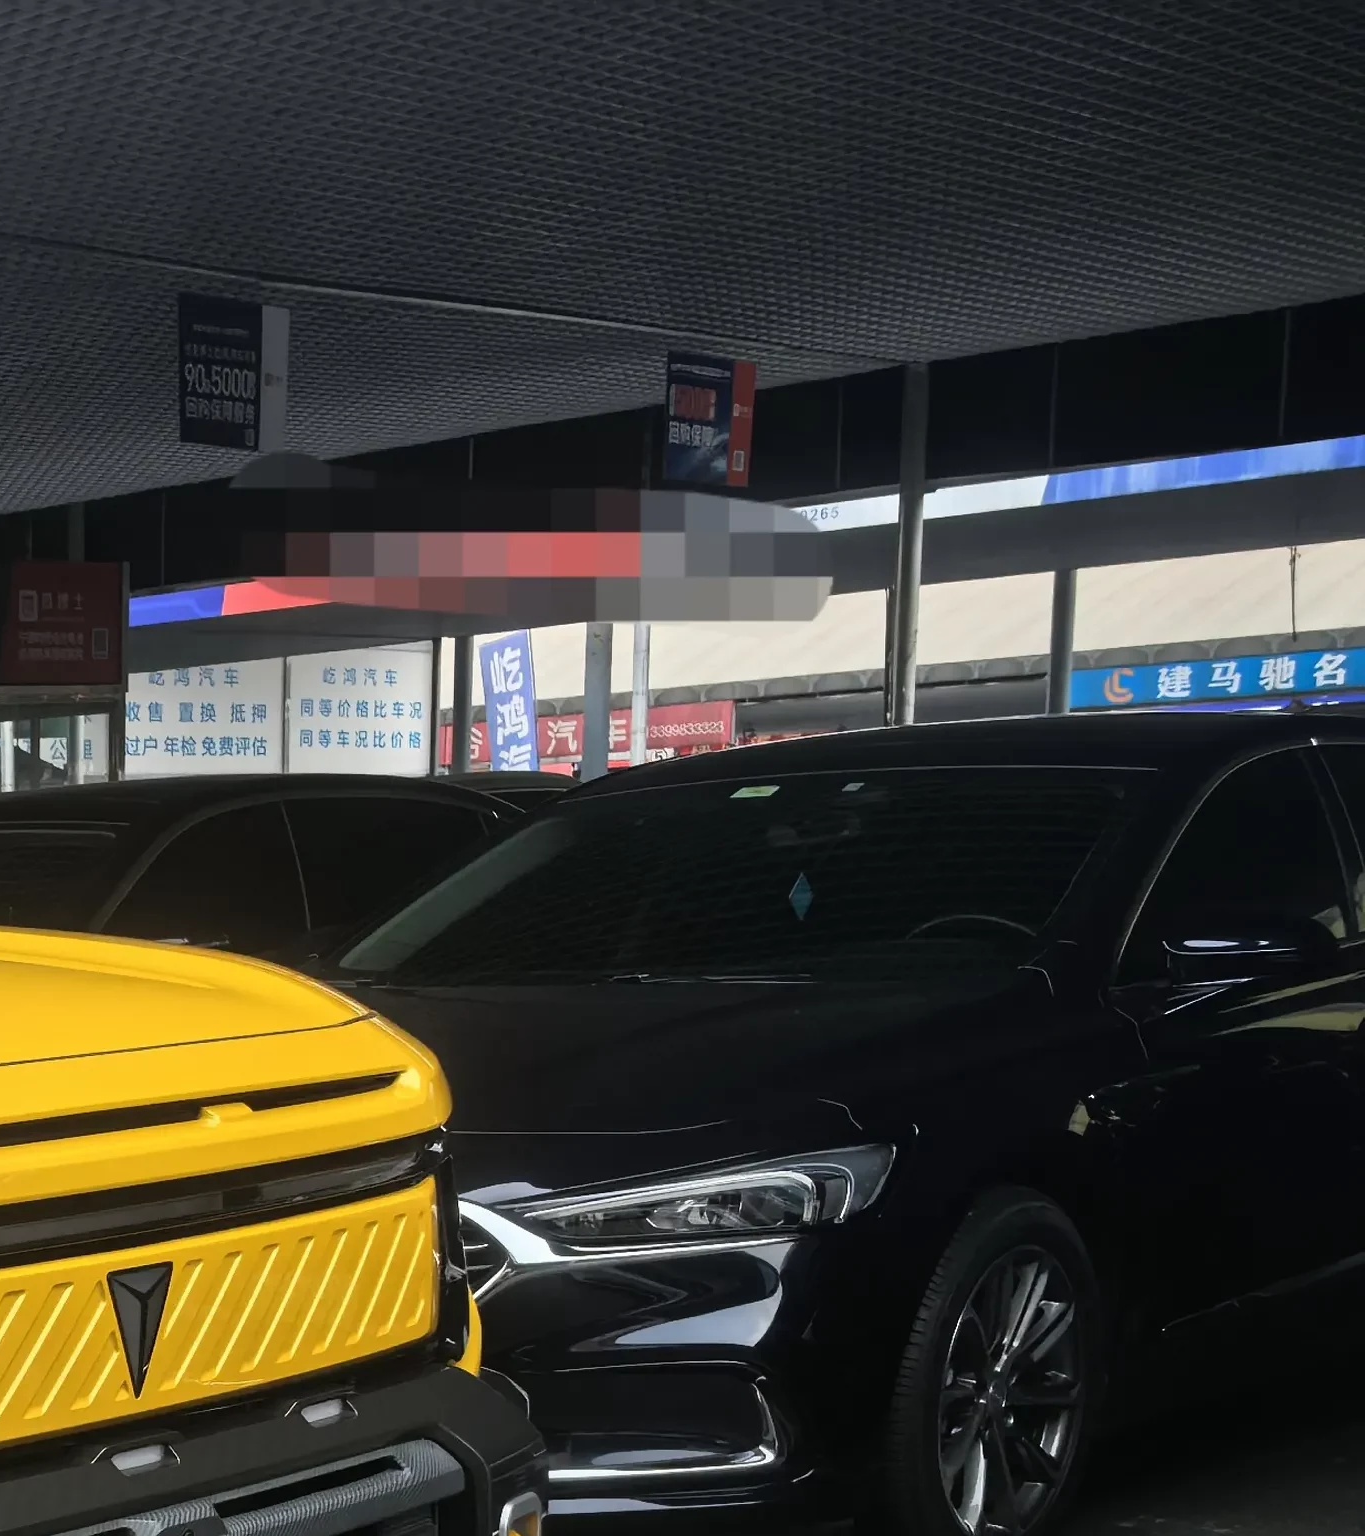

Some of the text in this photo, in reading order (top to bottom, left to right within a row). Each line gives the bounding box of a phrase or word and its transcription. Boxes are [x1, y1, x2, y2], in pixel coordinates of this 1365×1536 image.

[1157, 653, 1348, 699] 建马驰名
[230, 702, 267, 724] 抵押
[300, 698, 422, 719] 同等价格比车况
[202, 736, 267, 757] 免费评估
[299, 729, 421, 749] 同等车况比价格
